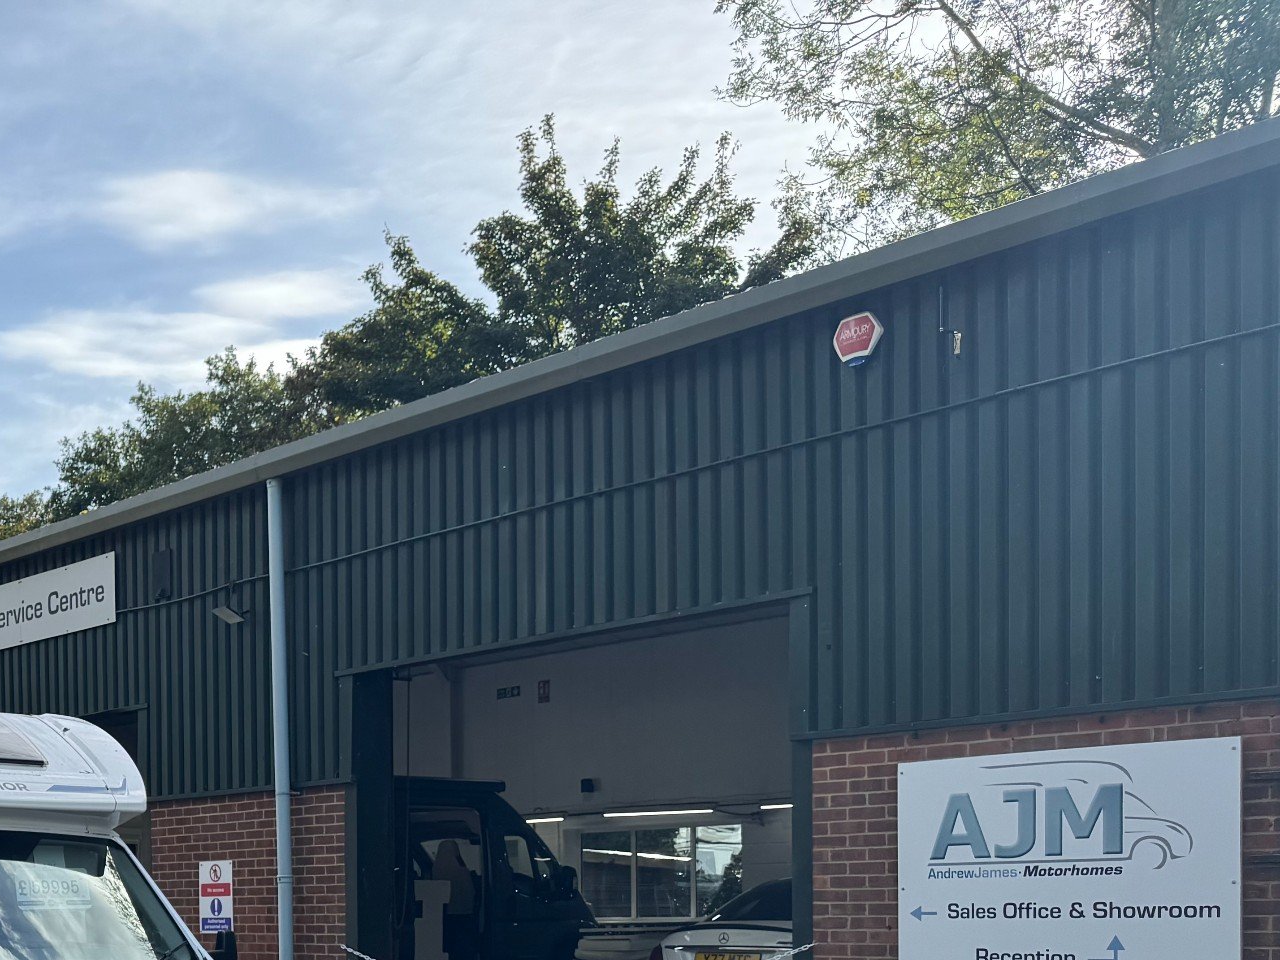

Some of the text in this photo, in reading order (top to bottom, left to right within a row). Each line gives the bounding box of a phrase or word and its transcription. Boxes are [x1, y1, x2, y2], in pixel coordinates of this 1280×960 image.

[840, 324, 870, 340] ARMOURY
[48, 584, 105, 616] Centre
[929, 782, 1124, 861] AJM
[947, 901, 1221, 919] Sales Office & Showroom
